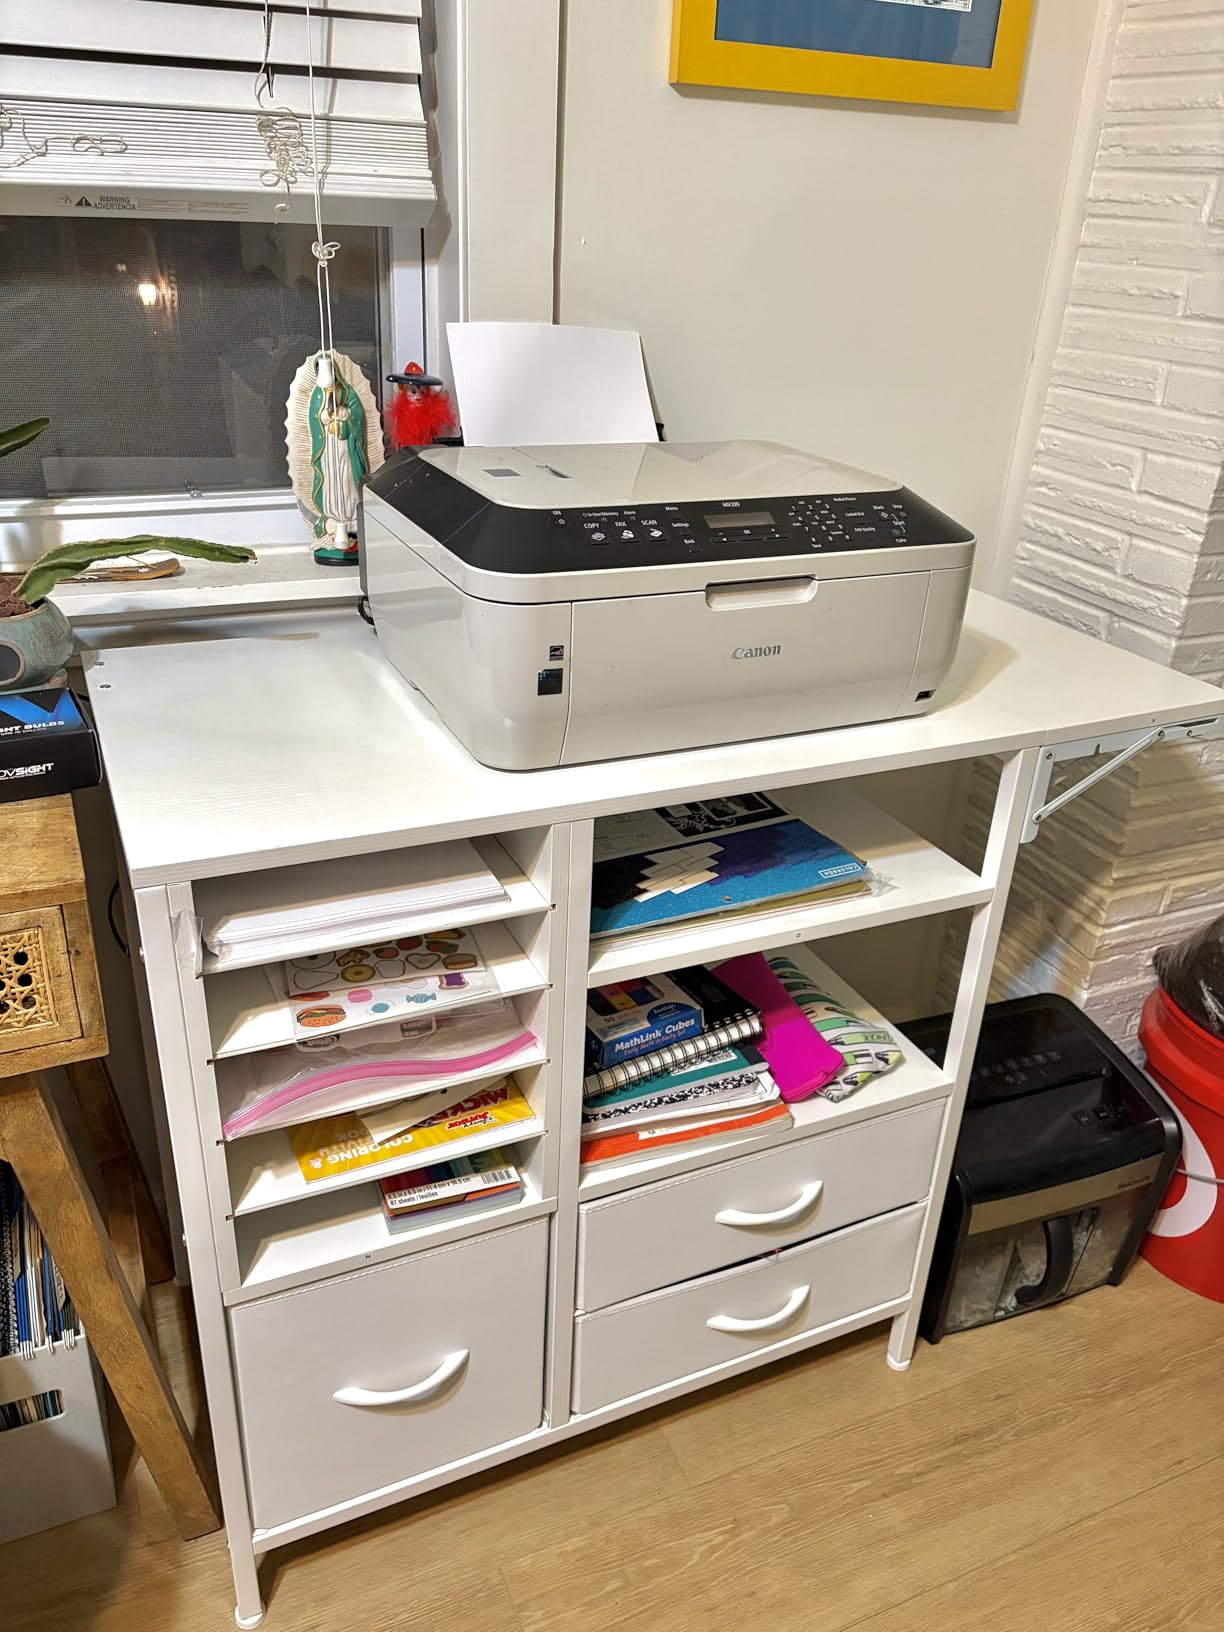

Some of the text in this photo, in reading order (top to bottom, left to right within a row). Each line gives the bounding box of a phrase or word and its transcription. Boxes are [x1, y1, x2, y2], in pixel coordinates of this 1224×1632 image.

[99, 195, 131, 203] WARNING
[93, 202, 137, 211] ADVERTENCIA
[731, 645, 781, 660] Canon
[24, 721, 66, 730] BULBS
[614, 1029, 663, 1053] MathLink
[665, 1018, 696, 1034] Cubes
[447, 1111, 489, 1130] Junior
[308, 1157, 323, 1169] &
[388, 1191, 397, 1200] 4.5
[408, 1187, 416, 1195] 6.5
[426, 1183, 438, 1191] 11.4
[398, 1195, 416, 1204] sheets
[418, 1191, 439, 1200] feuilles
